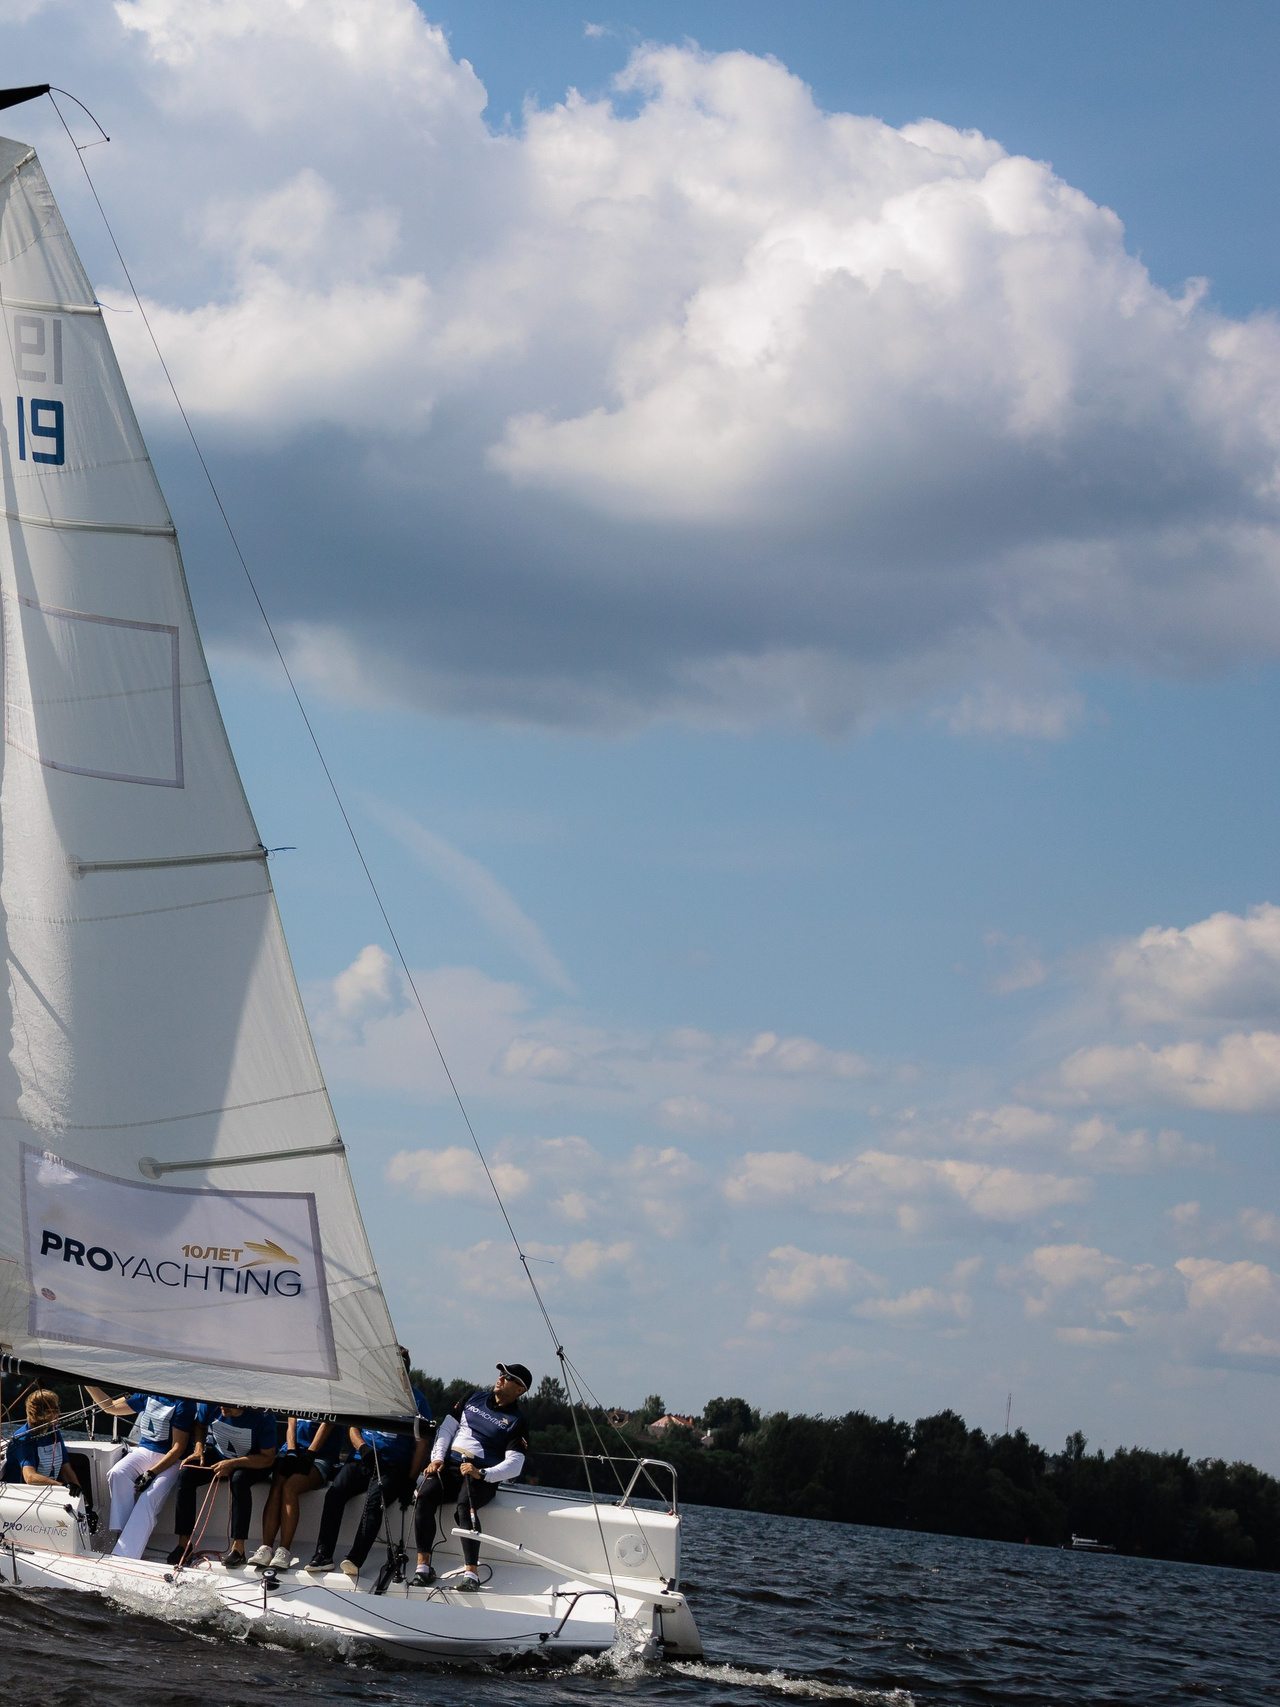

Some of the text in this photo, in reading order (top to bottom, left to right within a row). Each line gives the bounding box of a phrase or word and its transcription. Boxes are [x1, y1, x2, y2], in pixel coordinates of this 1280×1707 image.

[17, 396, 65, 466] 19
[40, 1230, 301, 1297] PROYACHTING
[2, 1521, 68, 1537] PROYACHTING
